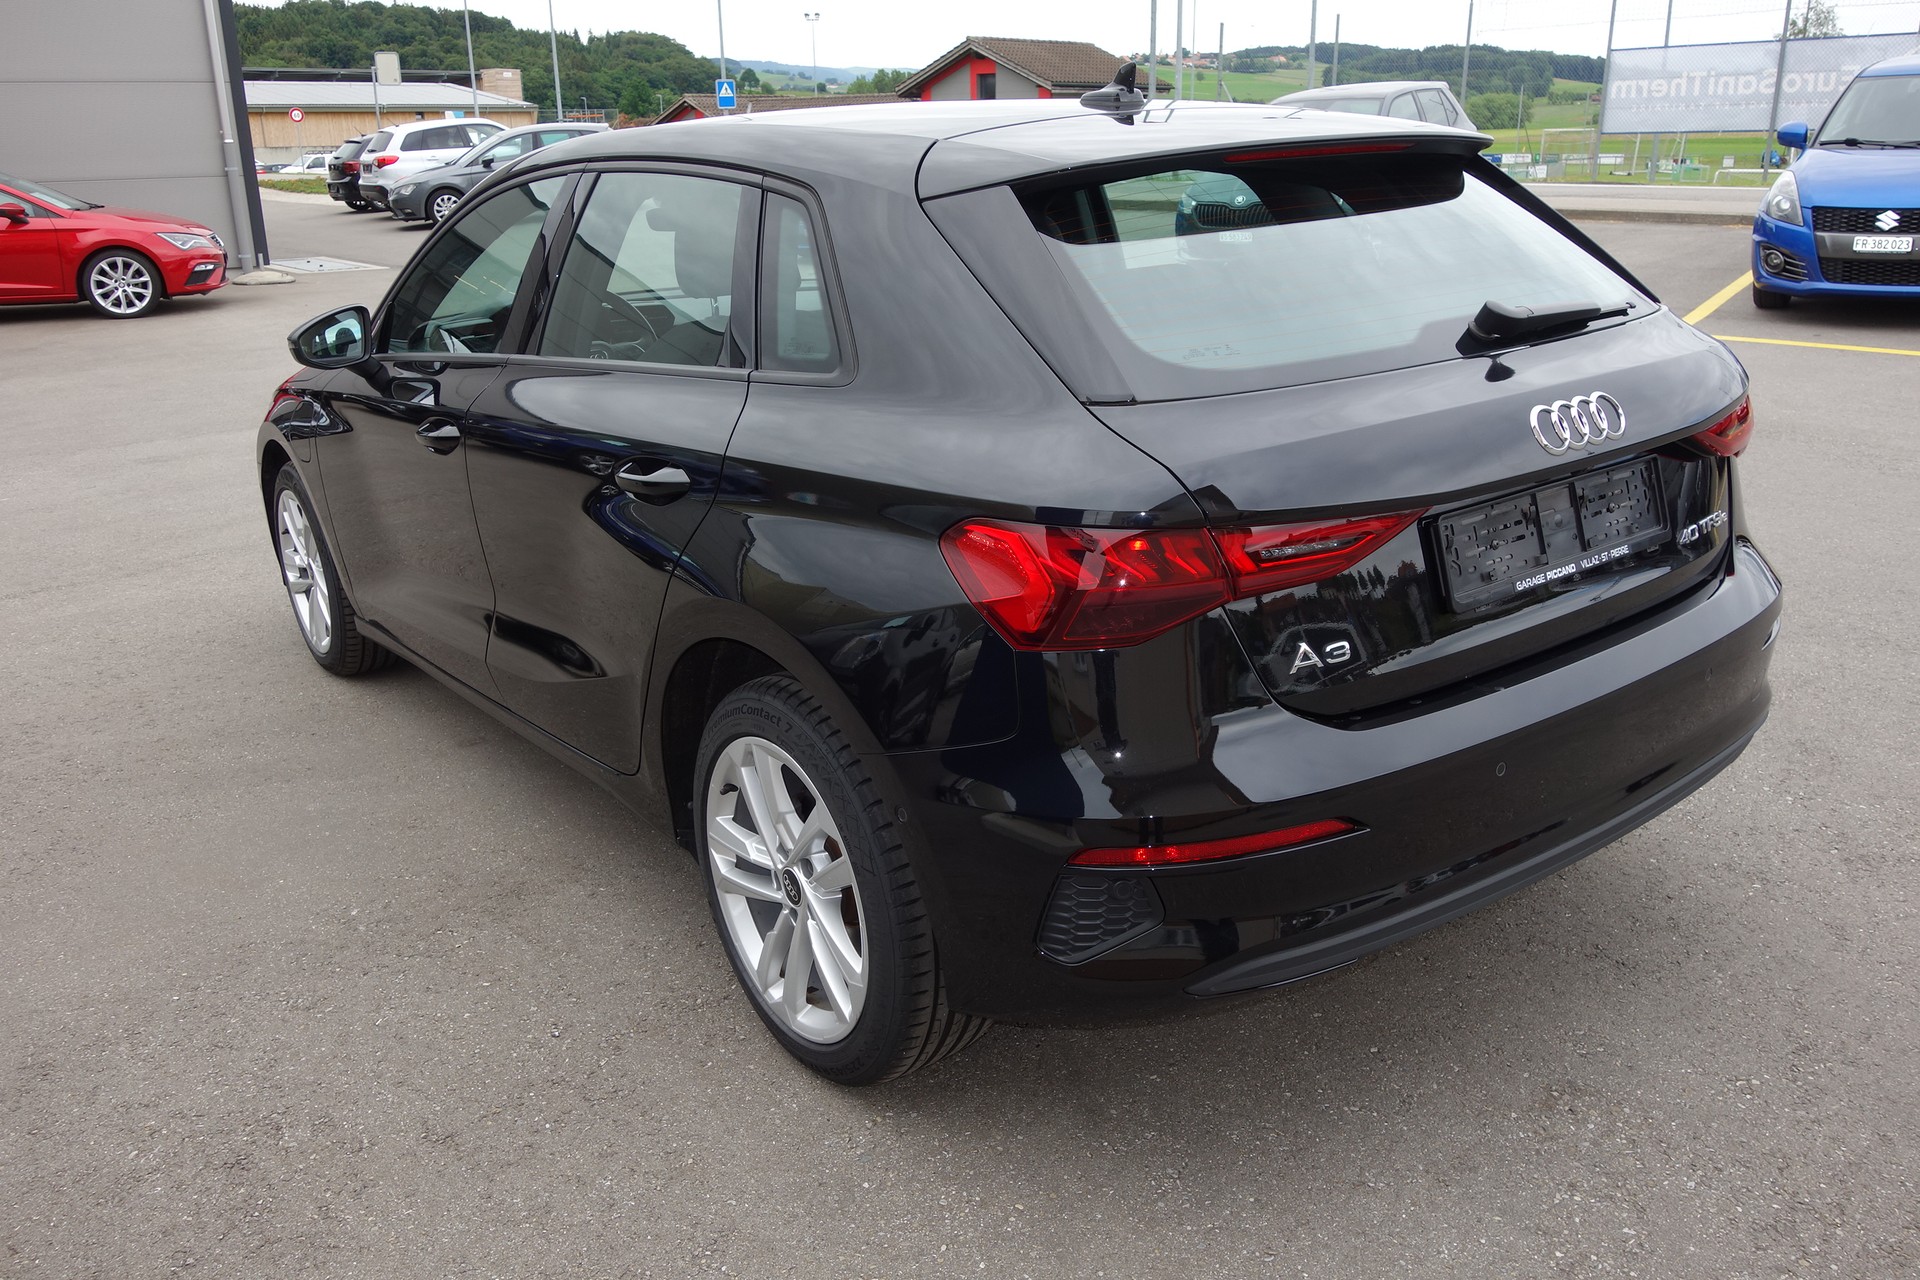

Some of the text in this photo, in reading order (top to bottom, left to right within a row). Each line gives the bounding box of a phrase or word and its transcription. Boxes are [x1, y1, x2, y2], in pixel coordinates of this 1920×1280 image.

[1676, 524, 1699, 545] 40
[1516, 573, 1546, 591] GARAGE
[1289, 641, 1351, 675] A3
[783, 721, 794, 734] 7
